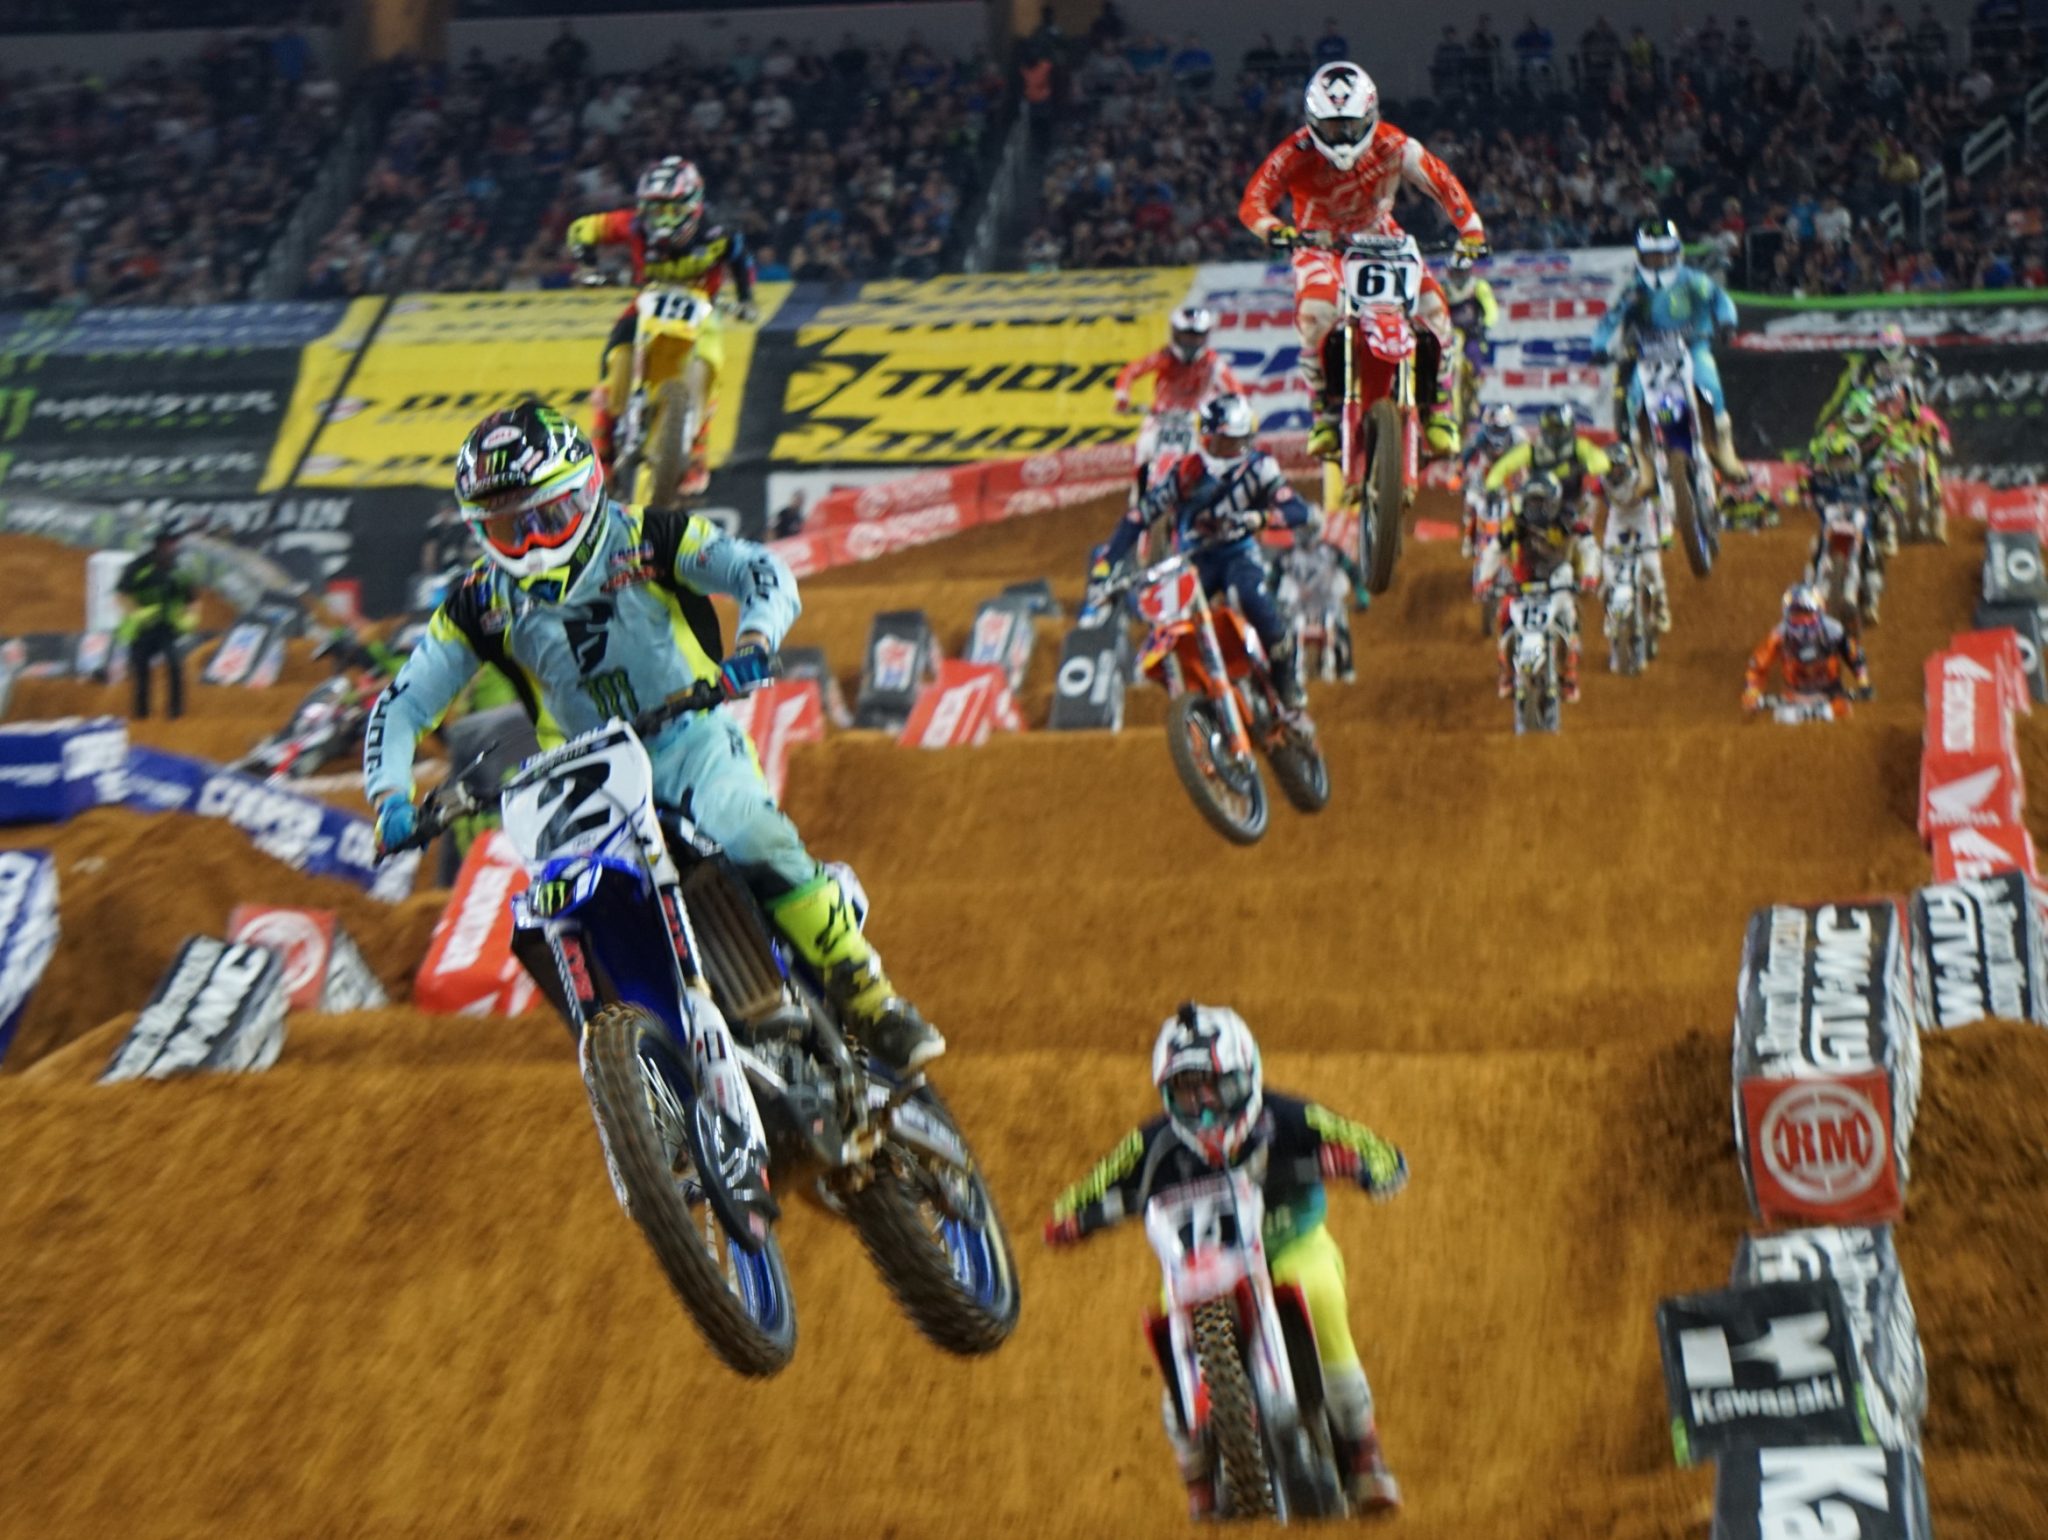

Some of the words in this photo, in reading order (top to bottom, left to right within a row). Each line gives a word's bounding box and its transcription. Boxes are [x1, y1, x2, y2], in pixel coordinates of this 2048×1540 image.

[1356, 263, 1409, 299] 61
[535, 761, 612, 861] 2
[1691, 1374, 1844, 1427] Kawasaki
